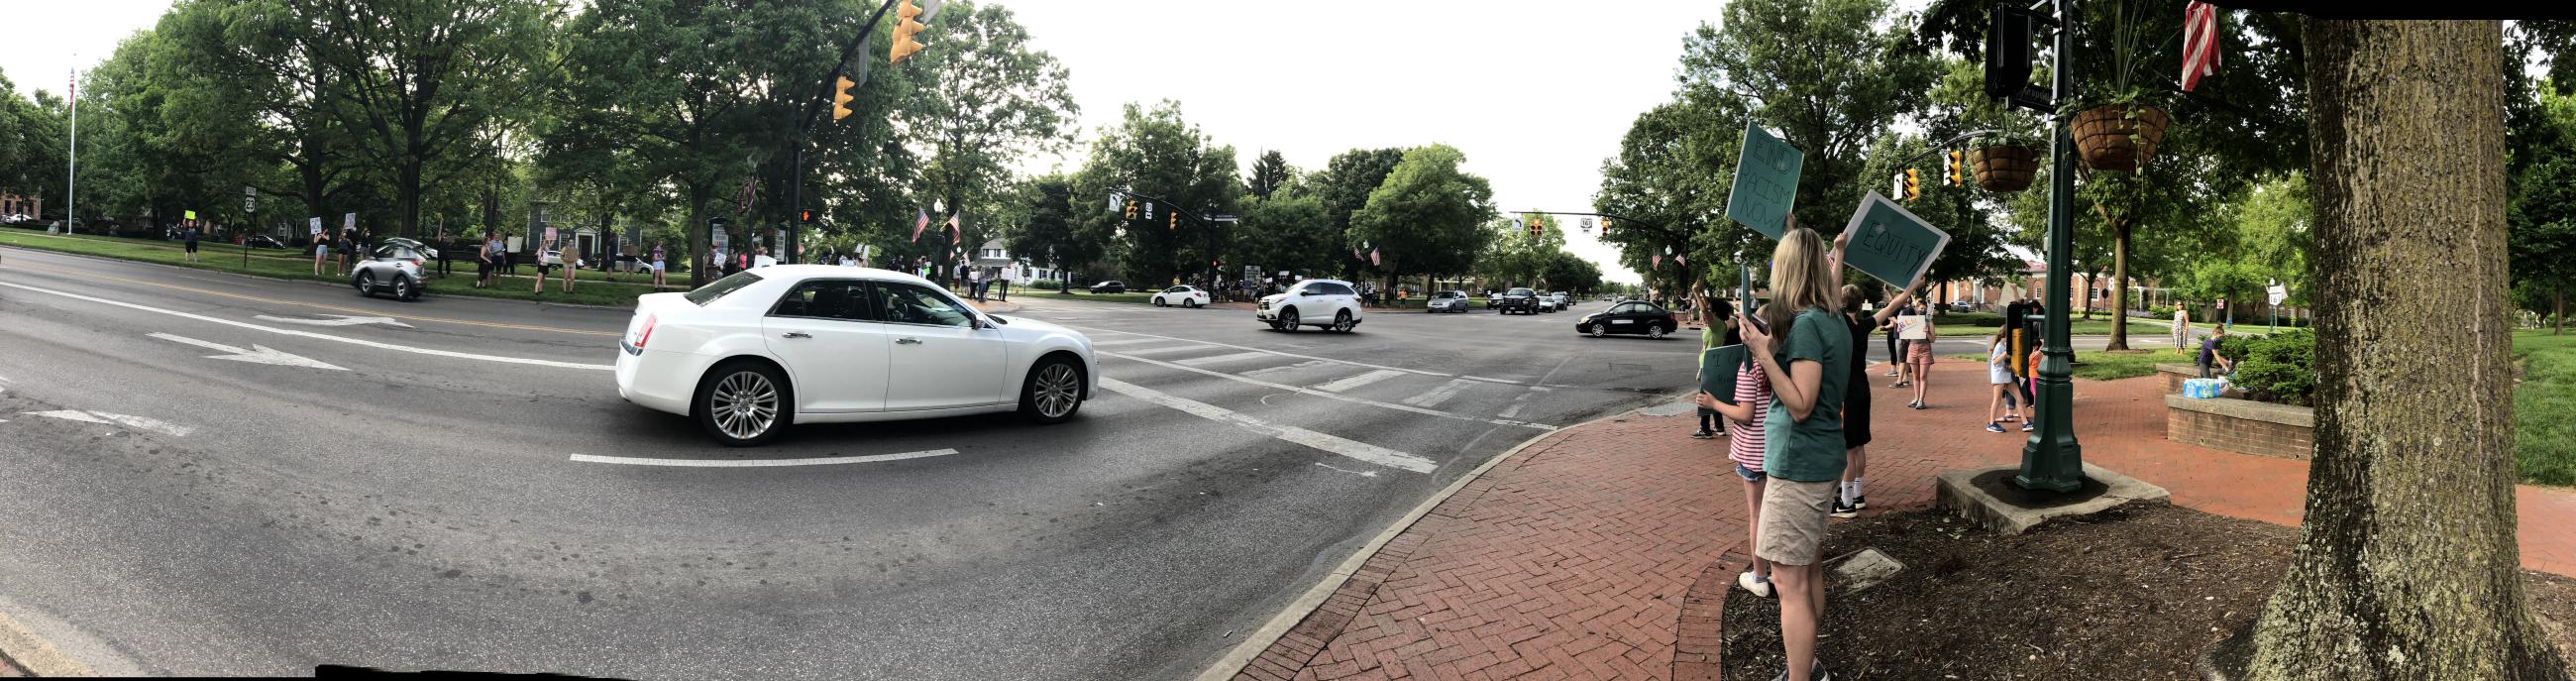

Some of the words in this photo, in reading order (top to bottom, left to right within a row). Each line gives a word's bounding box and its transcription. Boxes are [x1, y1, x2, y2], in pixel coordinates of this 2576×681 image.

[1753, 133, 1794, 175] END
[1738, 160, 1790, 207] RACISM
[246, 200, 255, 210] 23
[1739, 195, 1784, 229] NOW
[1863, 220, 1927, 277] EQUITY
